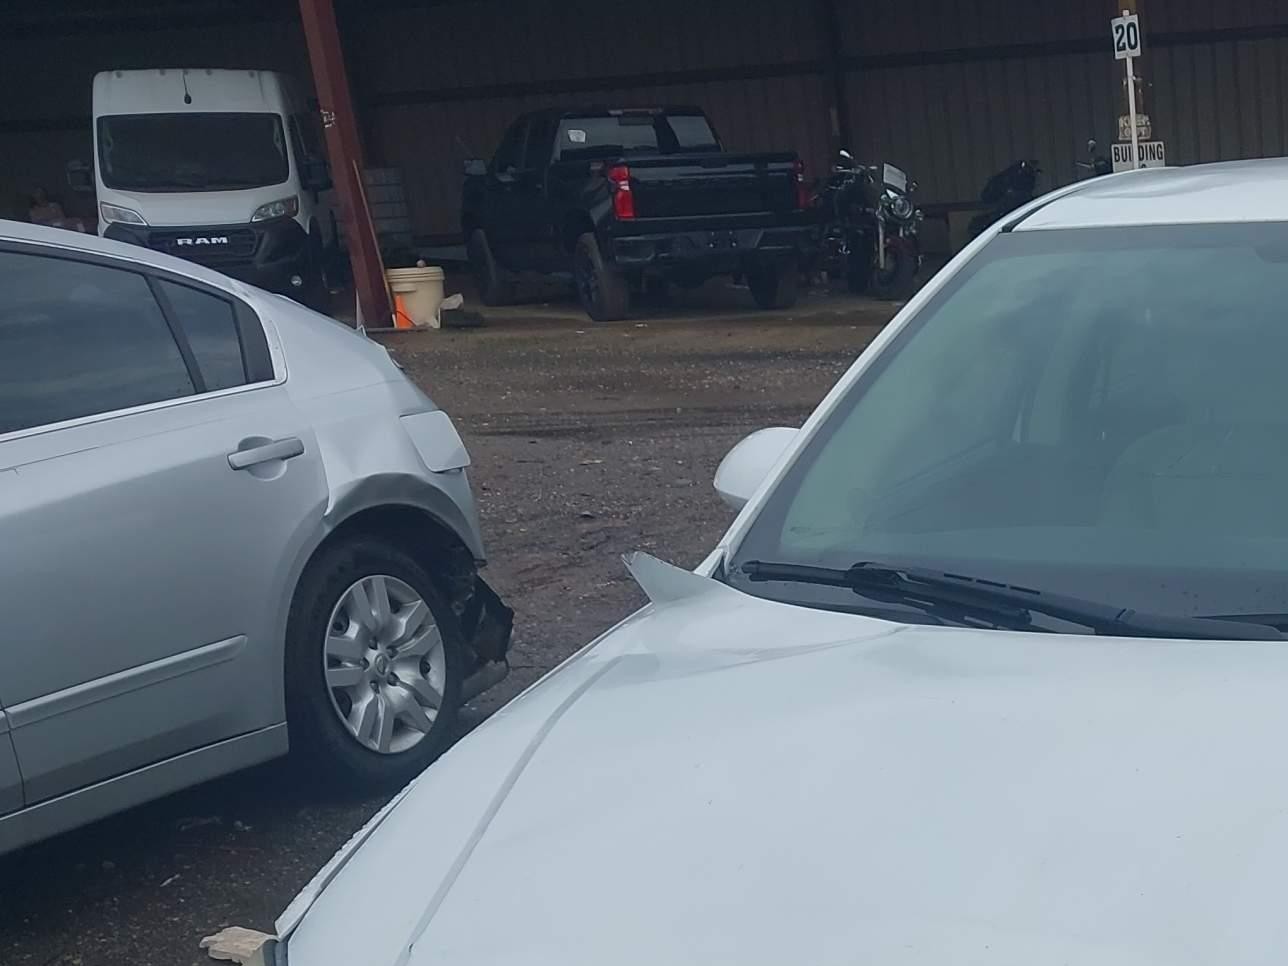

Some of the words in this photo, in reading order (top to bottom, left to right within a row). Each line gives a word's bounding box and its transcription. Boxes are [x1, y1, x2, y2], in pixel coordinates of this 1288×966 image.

[1114, 22, 1138, 52] 20
[1113, 143, 1164, 162] BUIDING
[176, 236, 228, 245] RAM
